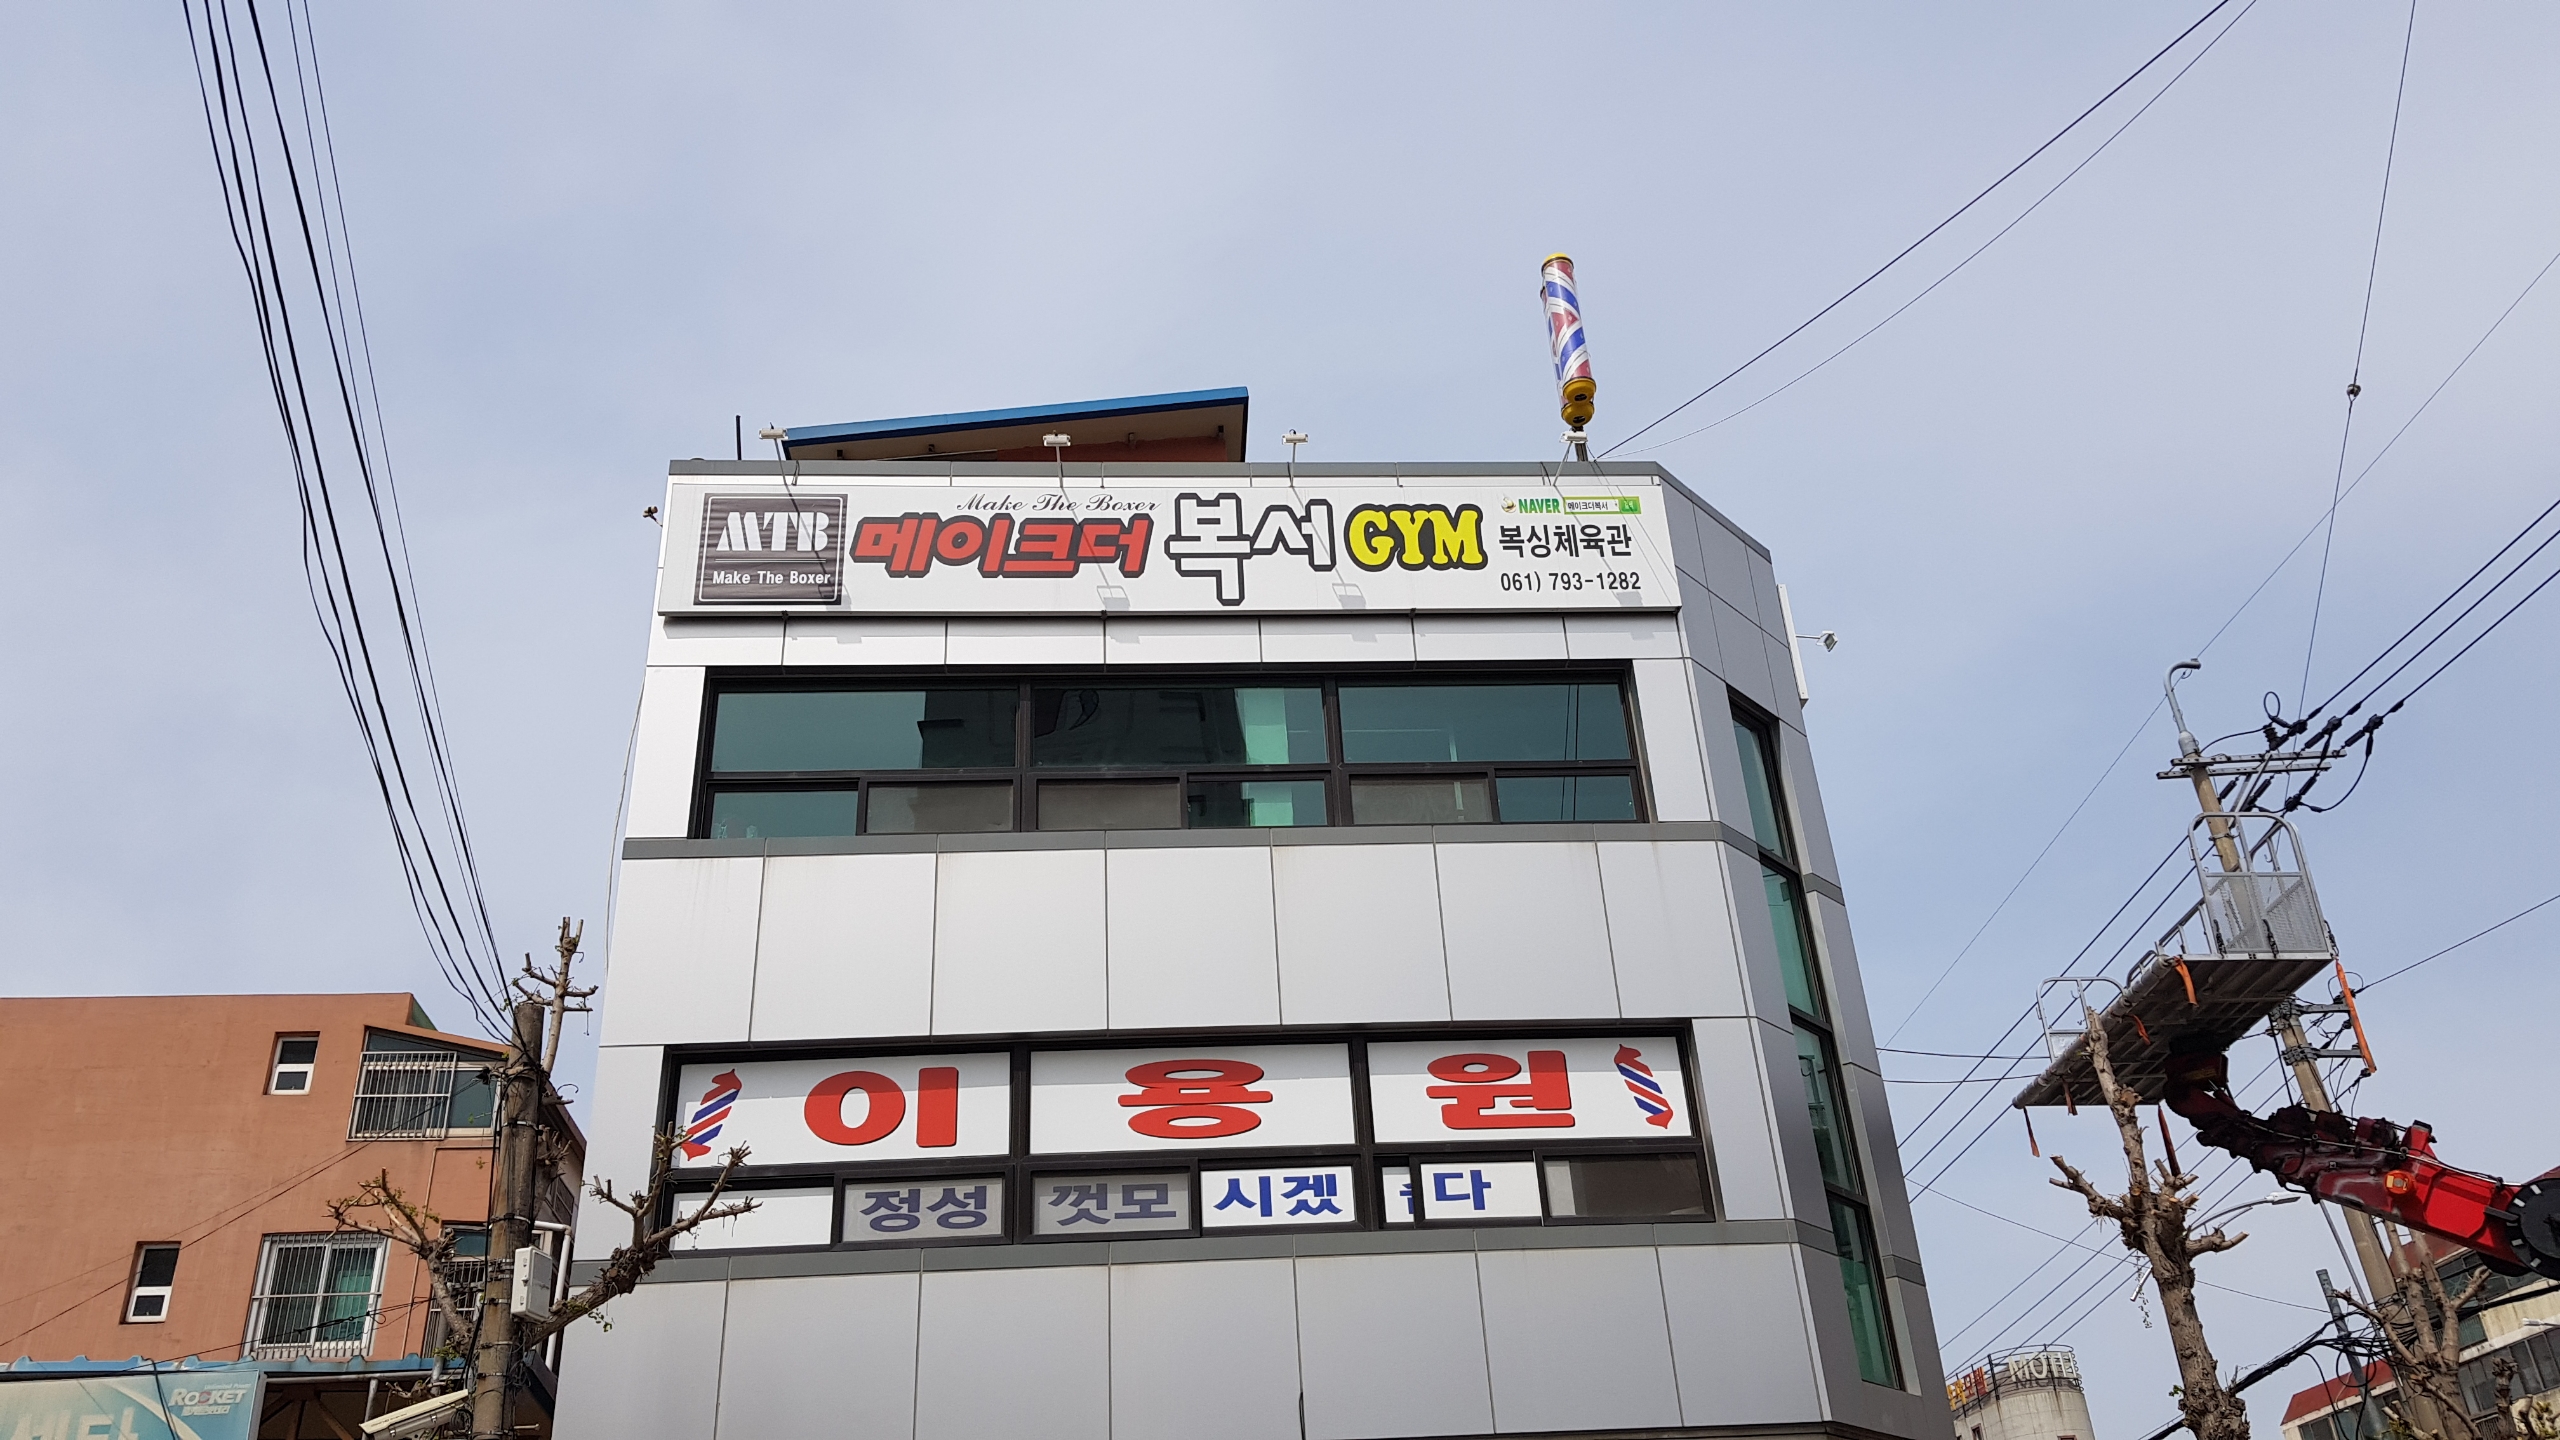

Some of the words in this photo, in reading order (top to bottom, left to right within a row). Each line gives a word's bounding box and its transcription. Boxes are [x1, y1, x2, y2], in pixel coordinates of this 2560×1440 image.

[956, 493, 1028, 512] Make
[1032, 493, 1082, 512] The
[1086, 493, 1161, 512] Boxer
[1518, 498, 1561, 514] NAVER
[716, 511, 830, 552] MTB
[1499, 524, 1632, 558] 복싱체육관
[850, 512, 1154, 578] 메이크더
[1164, 493, 1336, 606] 복서
[1343, 504, 1489, 572] GYM
[713, 571, 751, 585] Make
[758, 571, 784, 585] The
[789, 571, 831, 585] Boxer
[1500, 571, 1541, 593] 061)
[1548, 571, 1642, 591] 793-1282
[168, 1388, 247, 1407] ROCKET
